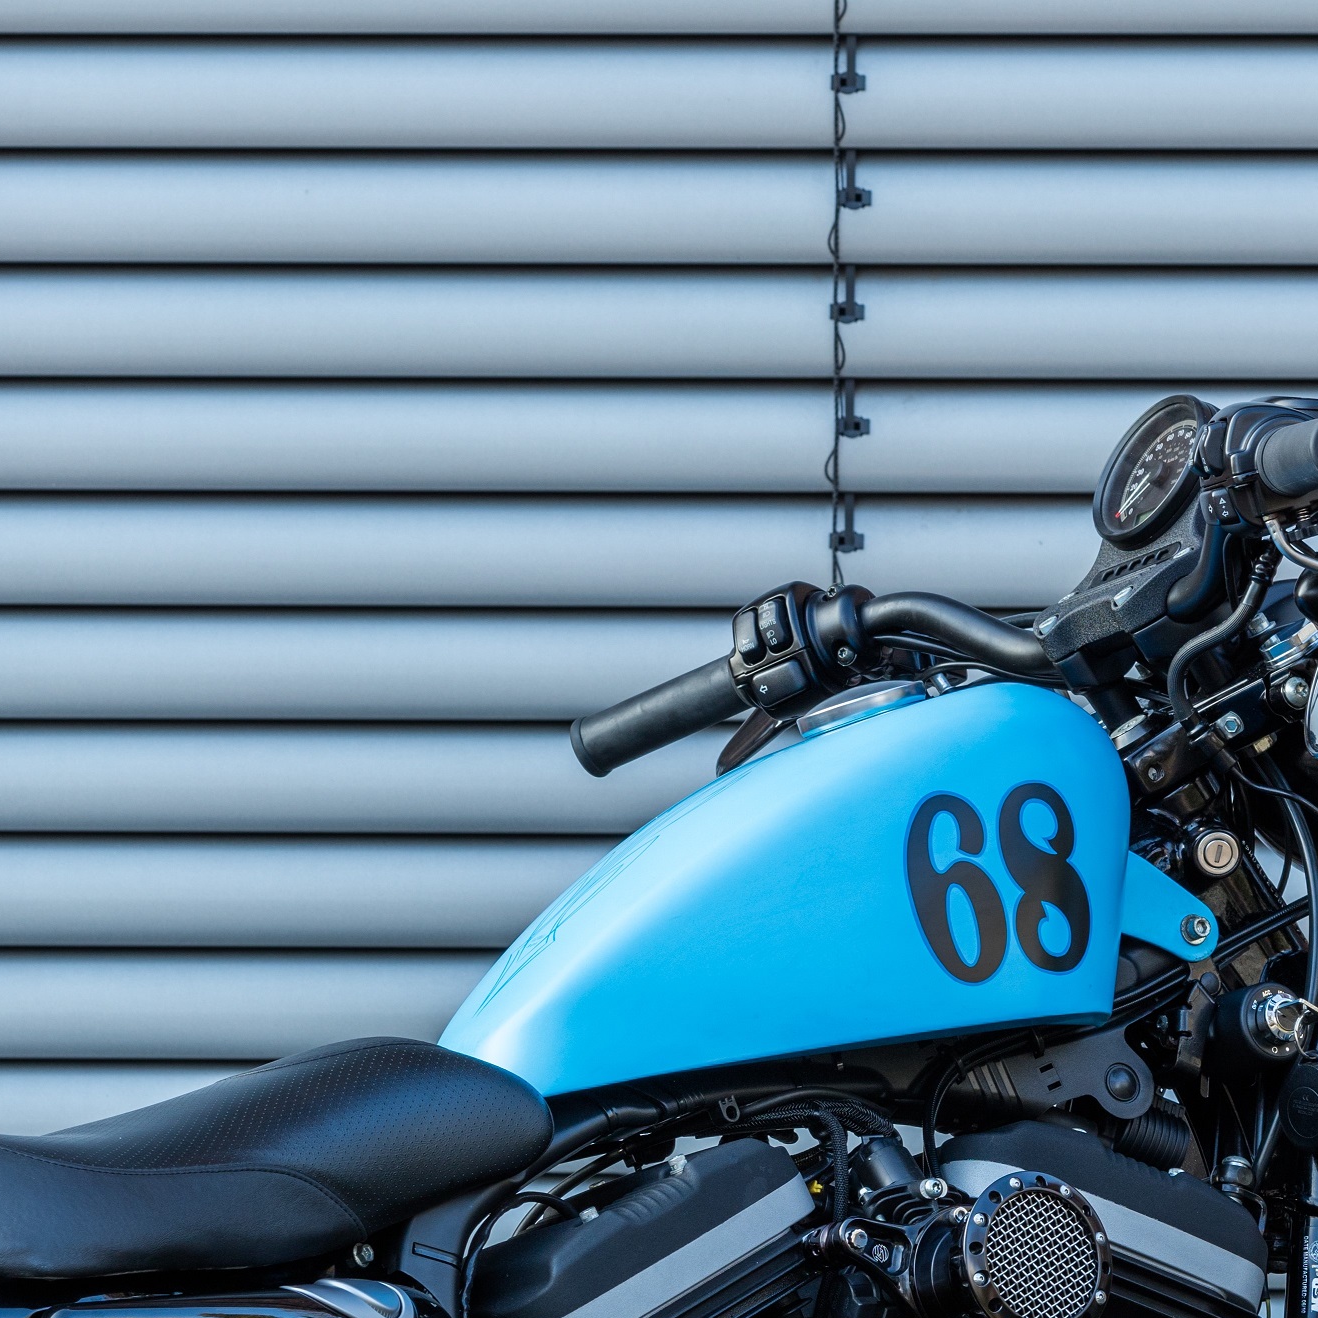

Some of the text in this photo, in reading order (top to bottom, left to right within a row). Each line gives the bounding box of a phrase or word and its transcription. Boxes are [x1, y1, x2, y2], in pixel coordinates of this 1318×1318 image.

[760, 618, 776, 630] LIGHTS
[740, 642, 754, 652] HORN
[903, 779, 1091, 986] 68
[1301, 1252, 1309, 1298] MANUFACTURED:
